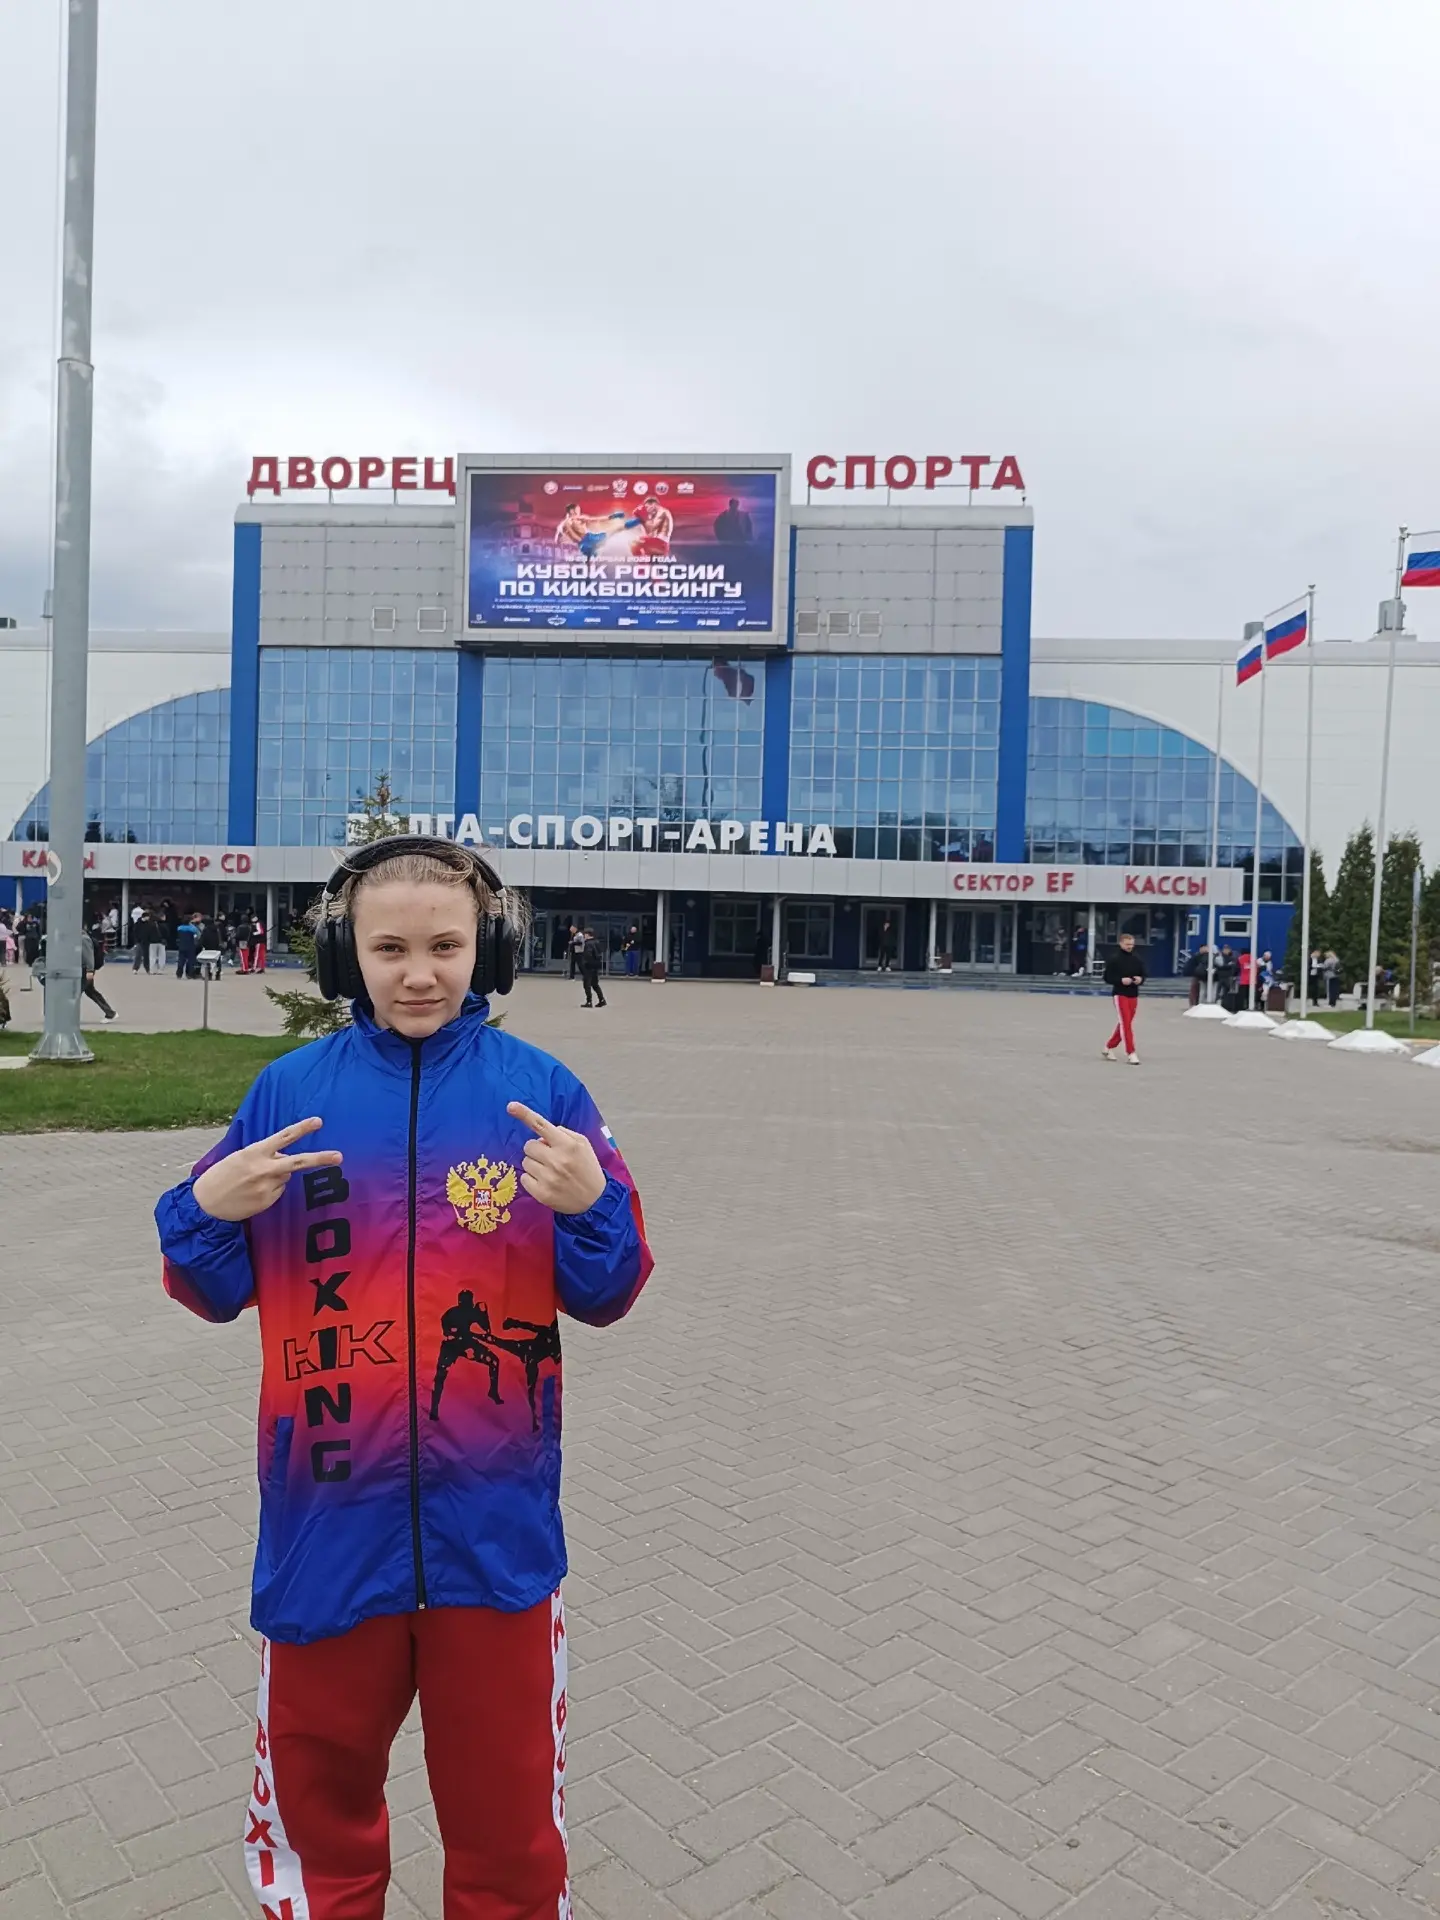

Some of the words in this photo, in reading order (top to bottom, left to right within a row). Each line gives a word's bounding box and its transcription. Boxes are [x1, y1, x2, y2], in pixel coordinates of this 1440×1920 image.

[247, 456, 456, 496] ДВОРЕЦ
[807, 455, 1025, 490] СПОРТА
[517, 563, 607, 580] КУБОК
[614, 564, 725, 581] РОССИИ
[499, 580, 536, 596] ПО
[542, 581, 742, 598] КИКБОКСИНГУ
[22, 849, 95, 870] КАЫ
[134, 854, 211, 872] СЕКТОР
[220, 853, 252, 874] CD
[953, 873, 1034, 892] СЕКТОР
[1046, 872, 1075, 893] EF
[1125, 874, 1207, 896] КАССЫ
[303, 1165, 352, 1484] BOXING
